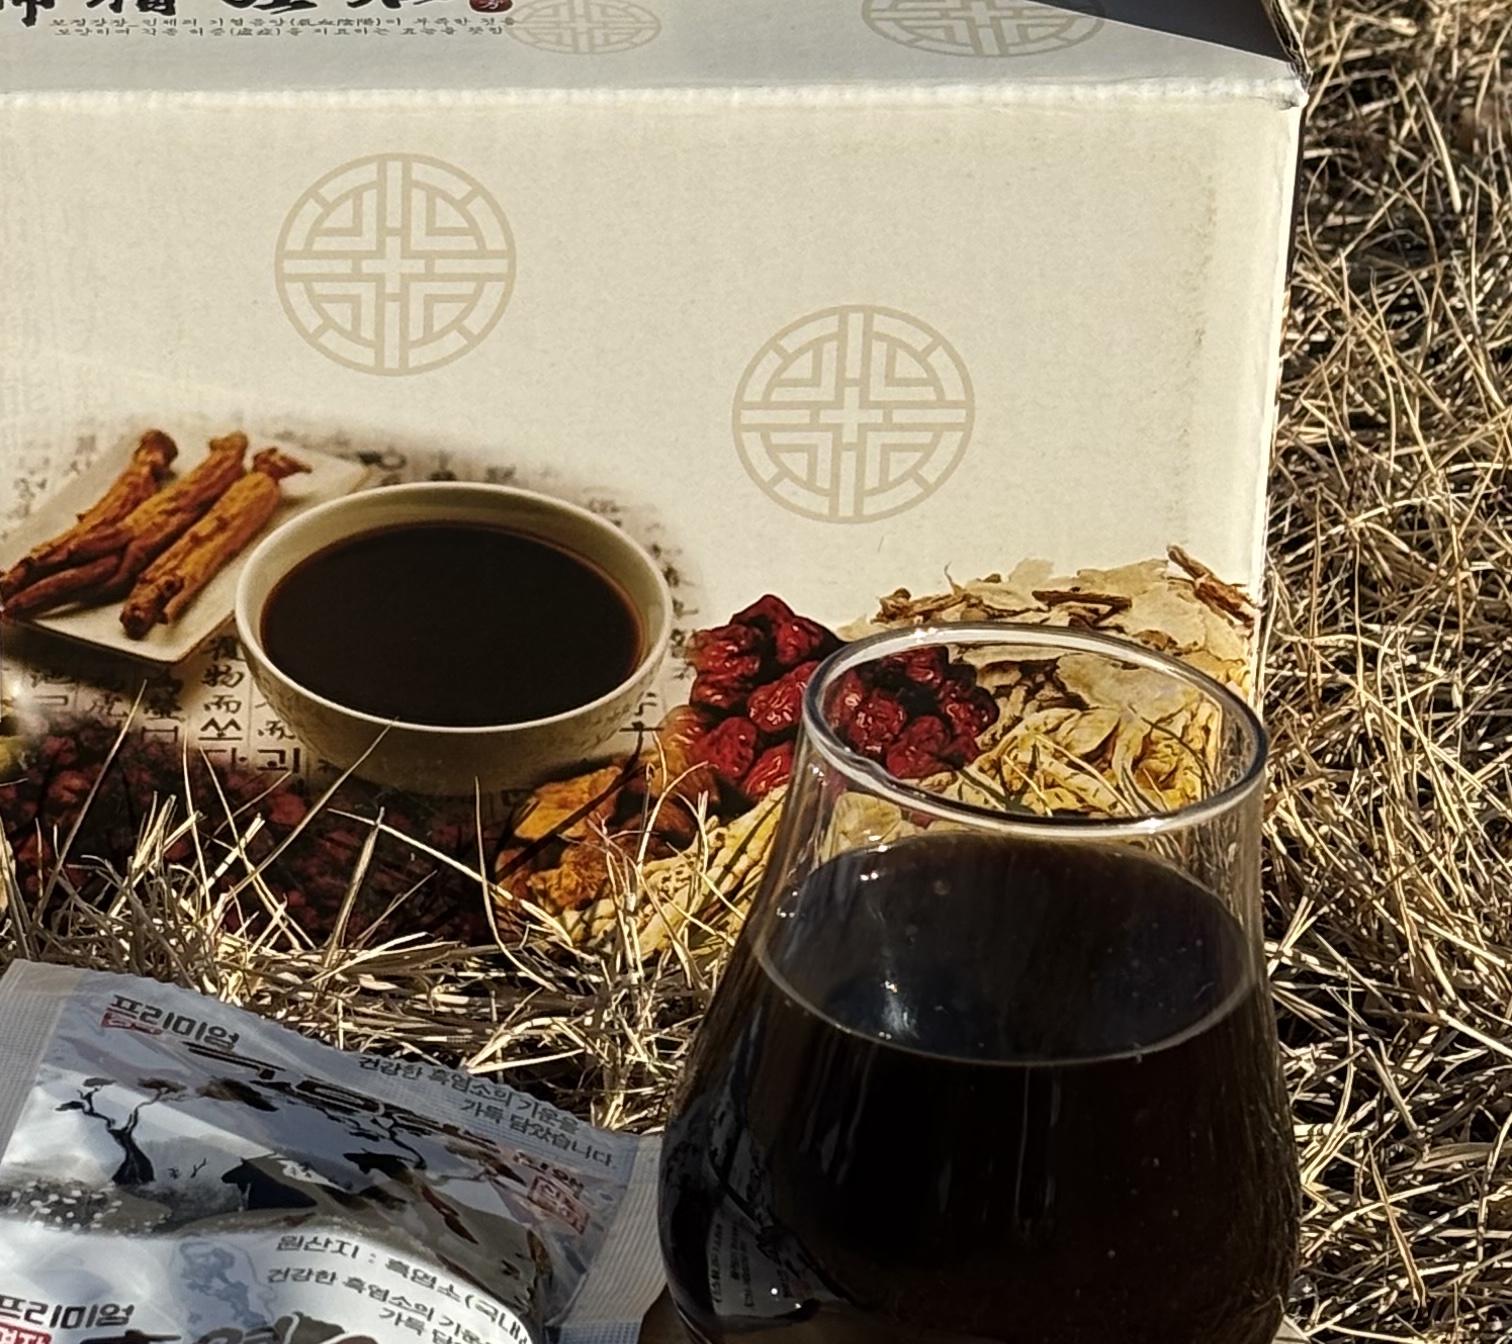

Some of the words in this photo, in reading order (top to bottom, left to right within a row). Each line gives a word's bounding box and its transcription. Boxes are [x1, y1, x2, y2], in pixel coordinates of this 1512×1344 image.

[106, 994, 240, 1050] 프리미엄
[359, 1056, 422, 1080] 건강한
[428, 1068, 513, 1106] 흑염소의
[461, 1099, 505, 1125] 가득
[277, 1234, 360, 1259] 원산지
[267, 1267, 338, 1286] 건강한
[342, 1276, 435, 1322] 흑염소의
[379, 1307, 426, 1336] 가득
